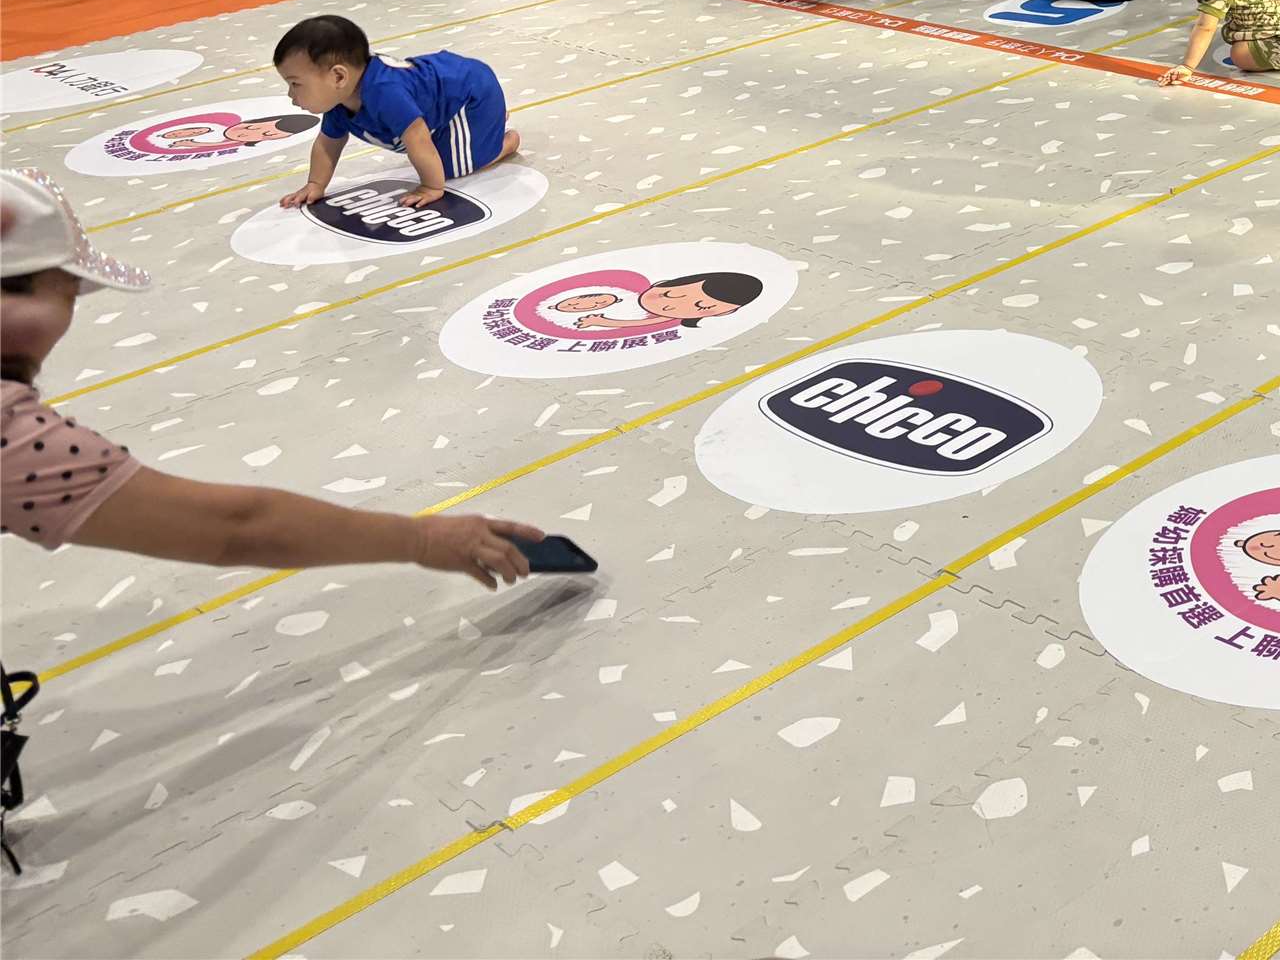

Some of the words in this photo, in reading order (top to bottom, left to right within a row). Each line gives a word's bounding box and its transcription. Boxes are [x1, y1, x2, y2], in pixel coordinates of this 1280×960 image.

[326, 189, 455, 237] chicco
[557, 329, 683, 353] 上聯展覽
[790, 376, 1007, 461] chicco
[1148, 504, 1226, 629] 婦幼採購首選
